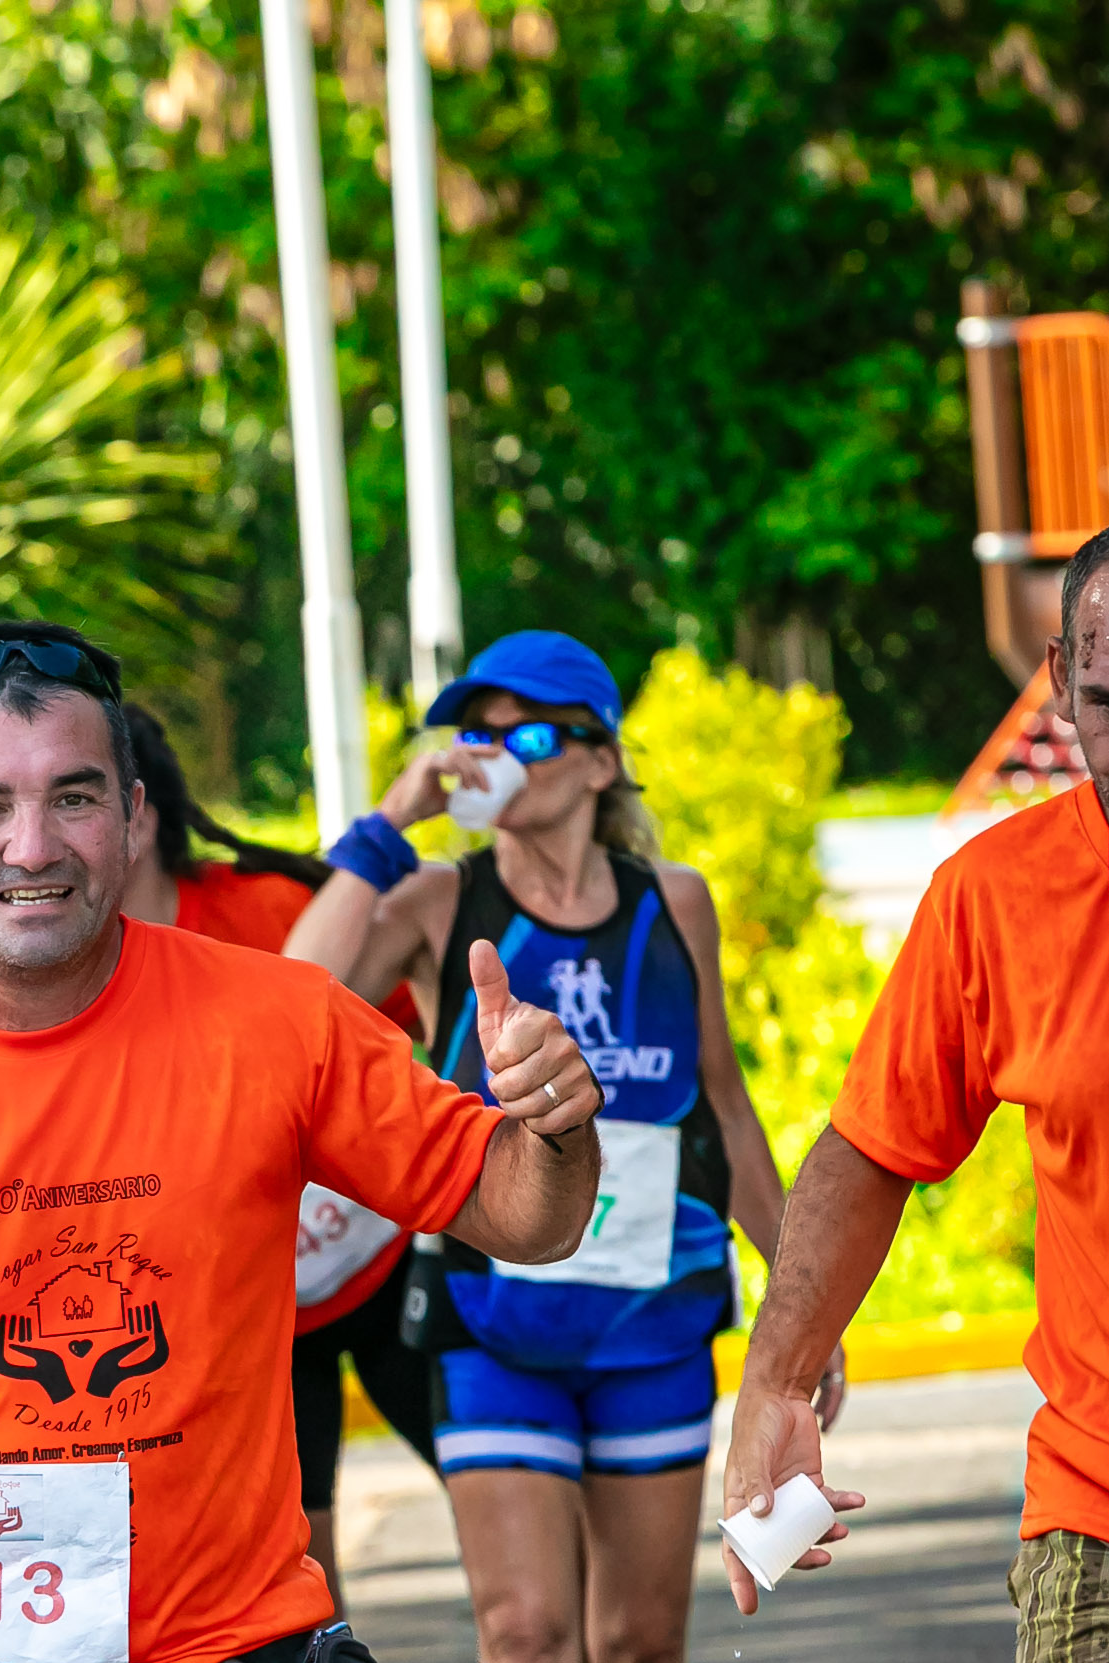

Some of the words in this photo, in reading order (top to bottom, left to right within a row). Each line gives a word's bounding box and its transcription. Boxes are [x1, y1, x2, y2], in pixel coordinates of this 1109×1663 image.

[579, 1046, 674, 1081] END
[22, 1174, 162, 1211] ANIVERSARIO
[50, 1225, 98, 1257] San
[107, 1233, 173, 1281] Roque
[14, 1403, 92, 1432] Desde
[104, 1381, 152, 1428] 1975
[72, 1442, 124, 1458] Creamos
[127, 1431, 183, 1453] Esperanza
